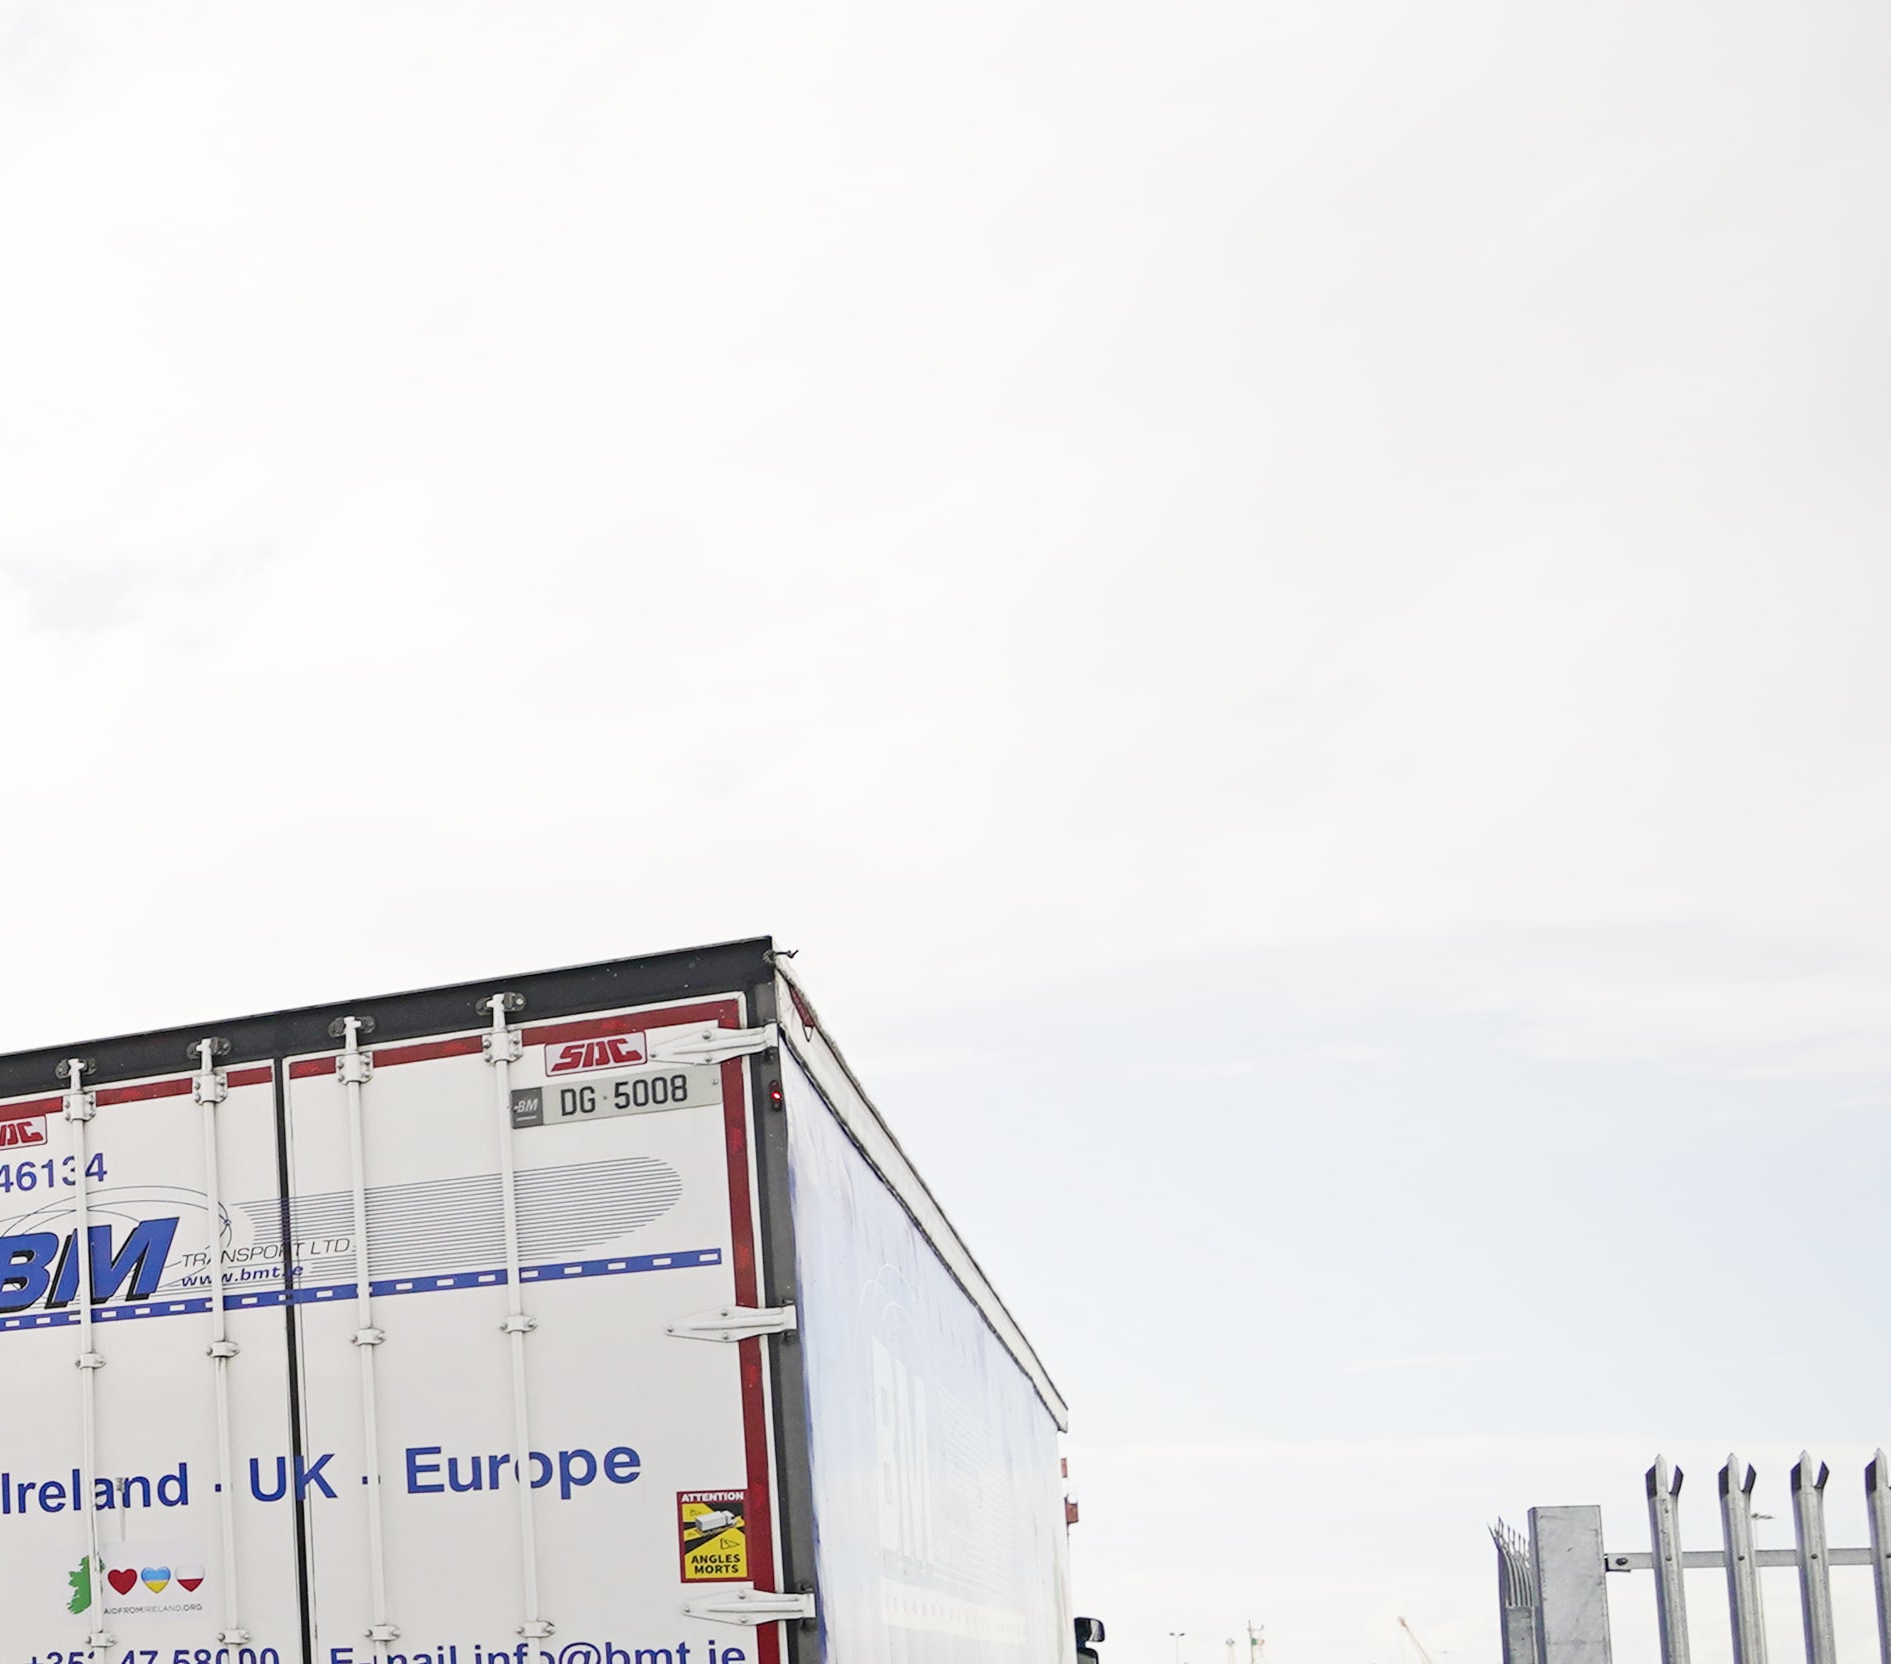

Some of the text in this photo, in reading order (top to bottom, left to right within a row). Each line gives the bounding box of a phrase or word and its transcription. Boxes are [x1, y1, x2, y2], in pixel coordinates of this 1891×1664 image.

[550, 1037, 643, 1072] SDC
[560, 1074, 688, 1116] DG 5008
[181, 1240, 307, 1268] TRNSPOT
[180, 1264, 304, 1288] www.bmt.e
[0, 1446, 644, 1516] Ireland UK Europe
[681, 1491, 744, 1503] ATTENTION
[691, 1553, 741, 1564] ANGLES
[694, 1564, 739, 1574] MORTS
